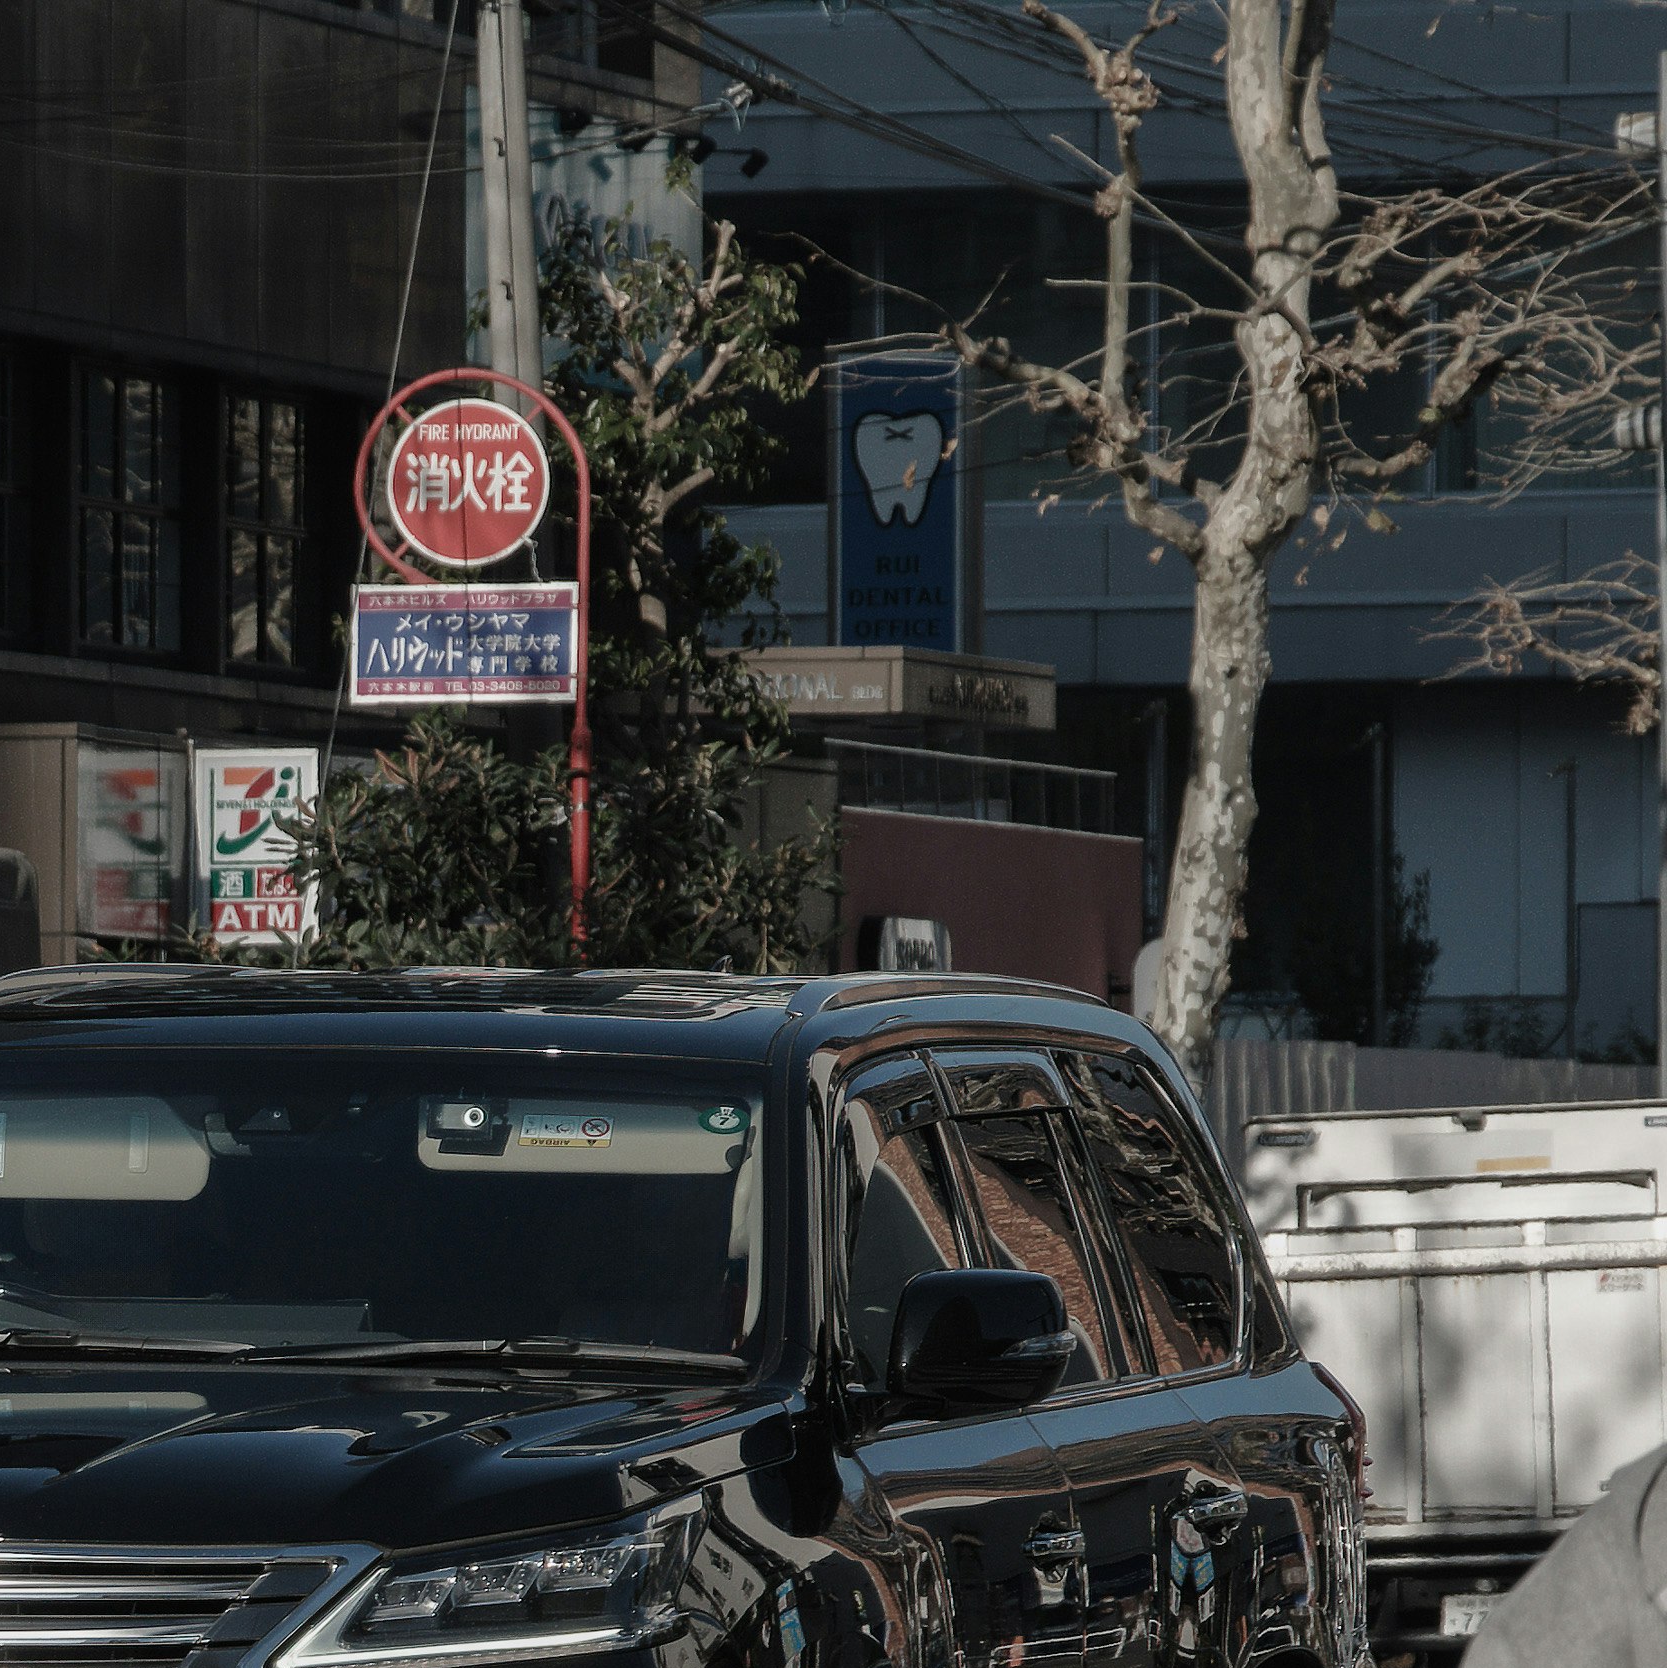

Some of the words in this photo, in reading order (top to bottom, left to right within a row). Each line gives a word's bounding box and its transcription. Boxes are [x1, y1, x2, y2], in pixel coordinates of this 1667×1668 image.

[419, 424, 450, 441] FIRE
[456, 423, 521, 440] HYDRANT
[406, 451, 535, 513] 消火栓
[876, 554, 919, 575] RUI
[848, 586, 945, 607] DENTAL
[854, 618, 940, 639] OFFICE
[366, 635, 464, 674] ハリウッド
[445, 681, 467, 692] TEL
[218, 903, 296, 930] ATM
